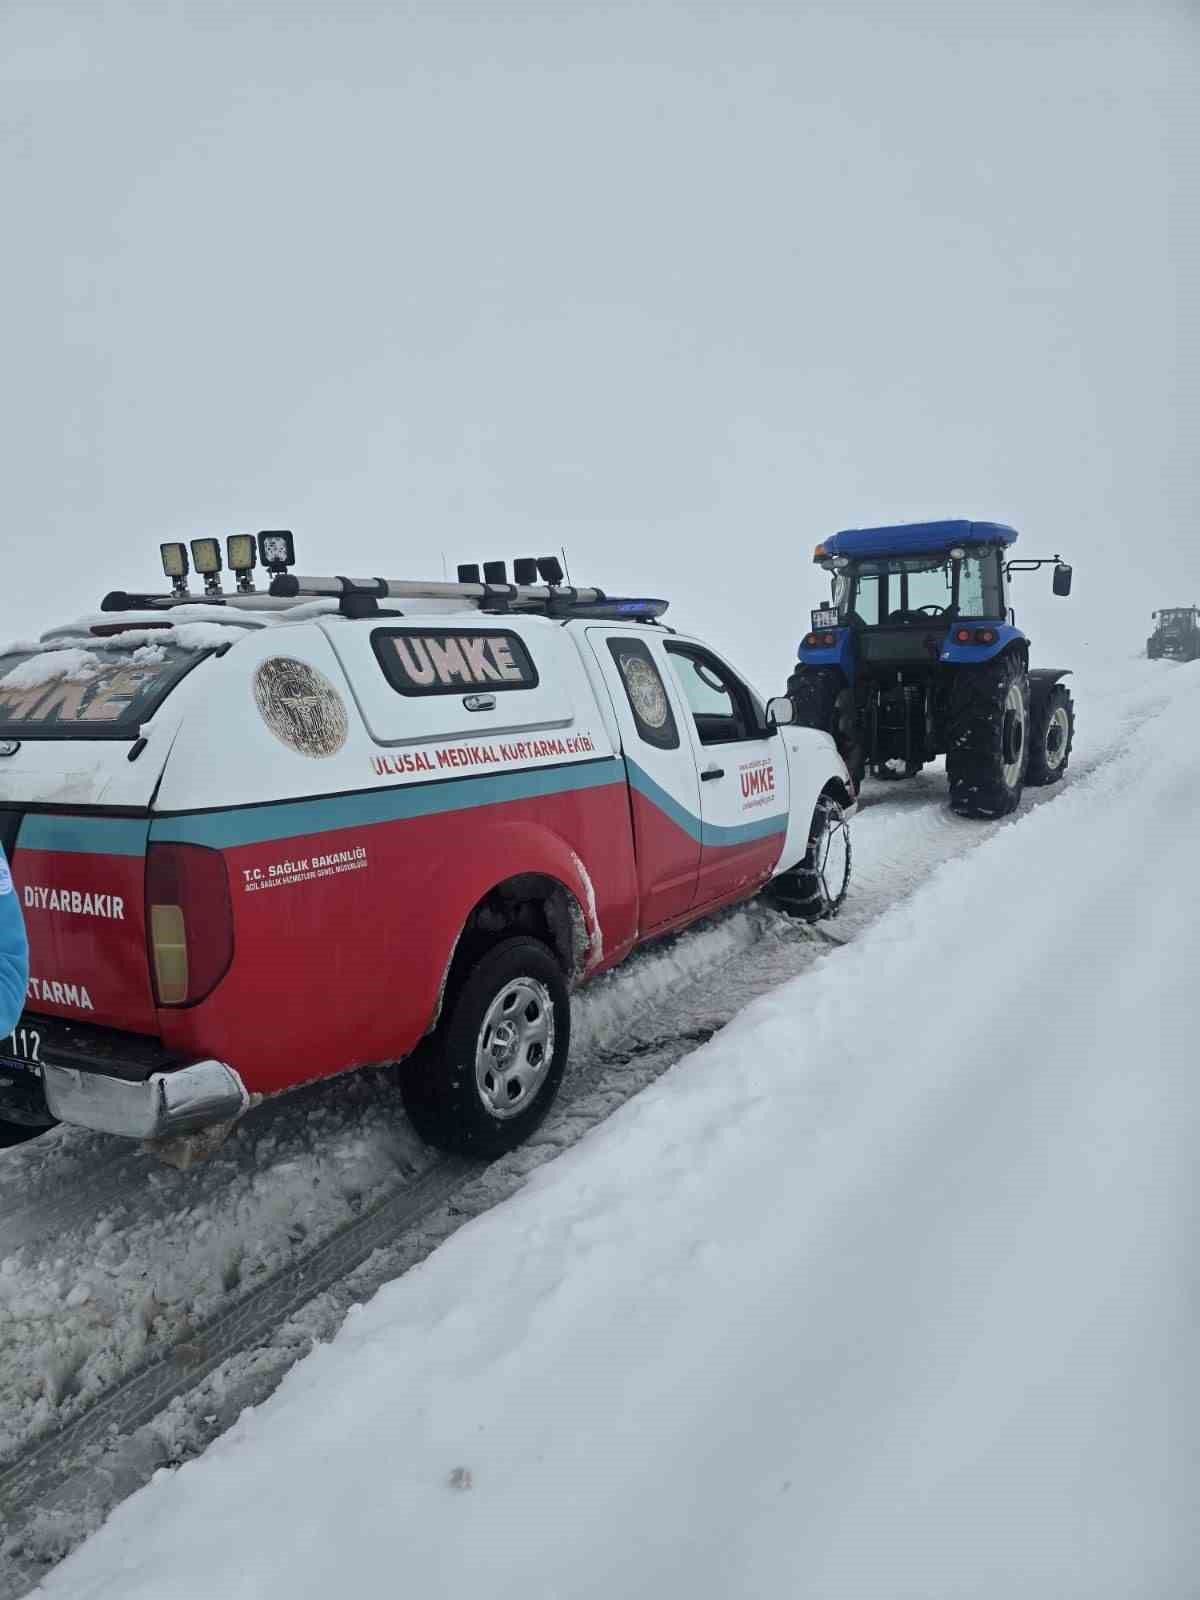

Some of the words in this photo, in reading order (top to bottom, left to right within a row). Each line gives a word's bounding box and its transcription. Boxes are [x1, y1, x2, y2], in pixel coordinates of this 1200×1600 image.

[392, 636, 524, 685] UMKE
[370, 751, 435, 776] ULUSAL
[436, 745, 499, 768] MEDİKAL
[500, 739, 566, 762] KURTARMA
[566, 732, 595, 754] EKİBİ
[740, 766, 775, 798] UMKE
[243, 869, 265, 881] T.C.
[268, 859, 309, 877] SAĞLIK
[312, 846, 366, 868] BAKANLIĞI
[10, 1028, 40, 1061] 112
